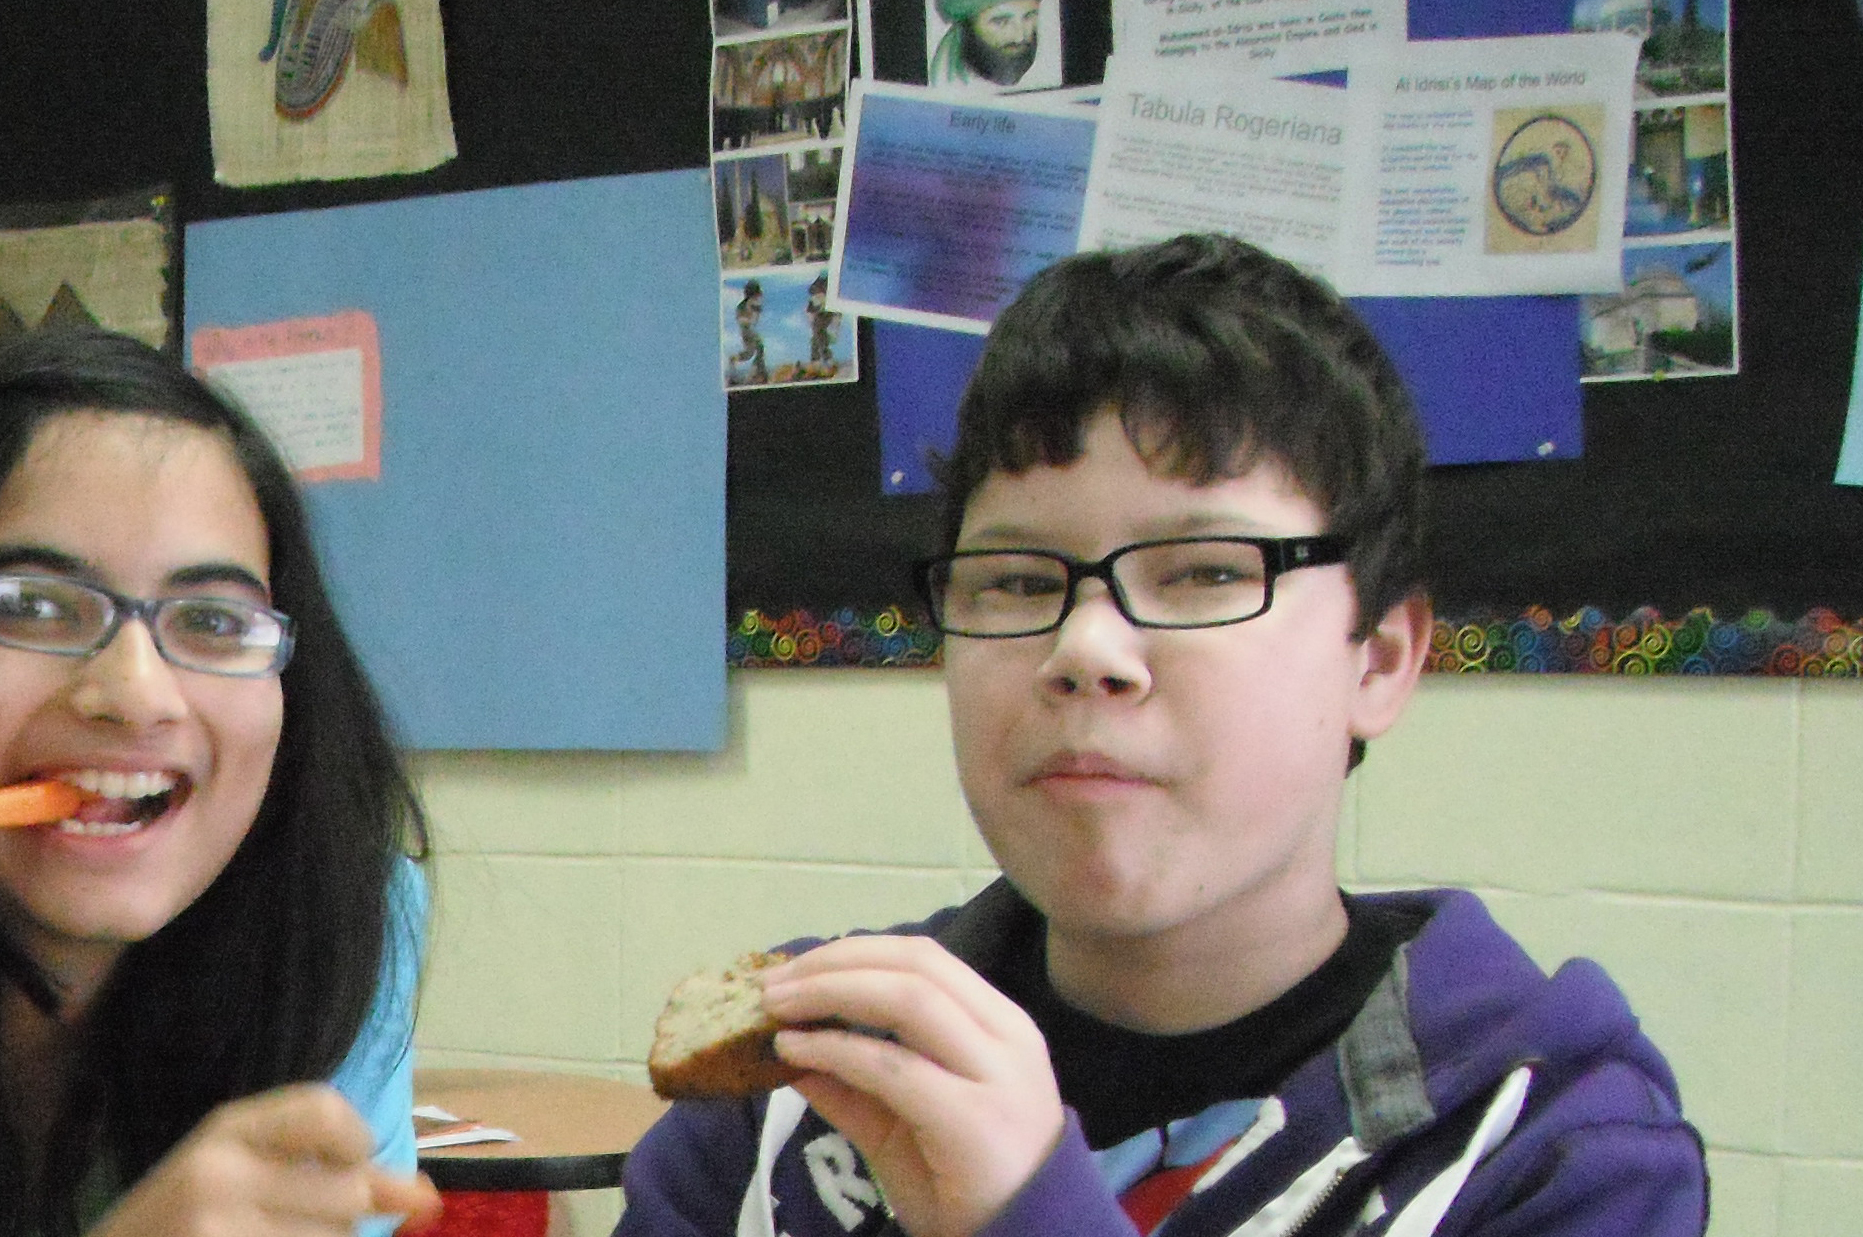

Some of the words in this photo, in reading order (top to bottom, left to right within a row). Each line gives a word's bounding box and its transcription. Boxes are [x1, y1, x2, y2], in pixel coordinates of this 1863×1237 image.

[1466, 73, 1497, 92] Map
[1501, 73, 1516, 89] of
[1518, 74, 1541, 88] the
[1546, 71, 1585, 87] World
[950, 111, 988, 135] Early
[993, 116, 1016, 133] life
[1129, 92, 1206, 128] Tabula
[1213, 104, 1343, 145] Rogeriana
